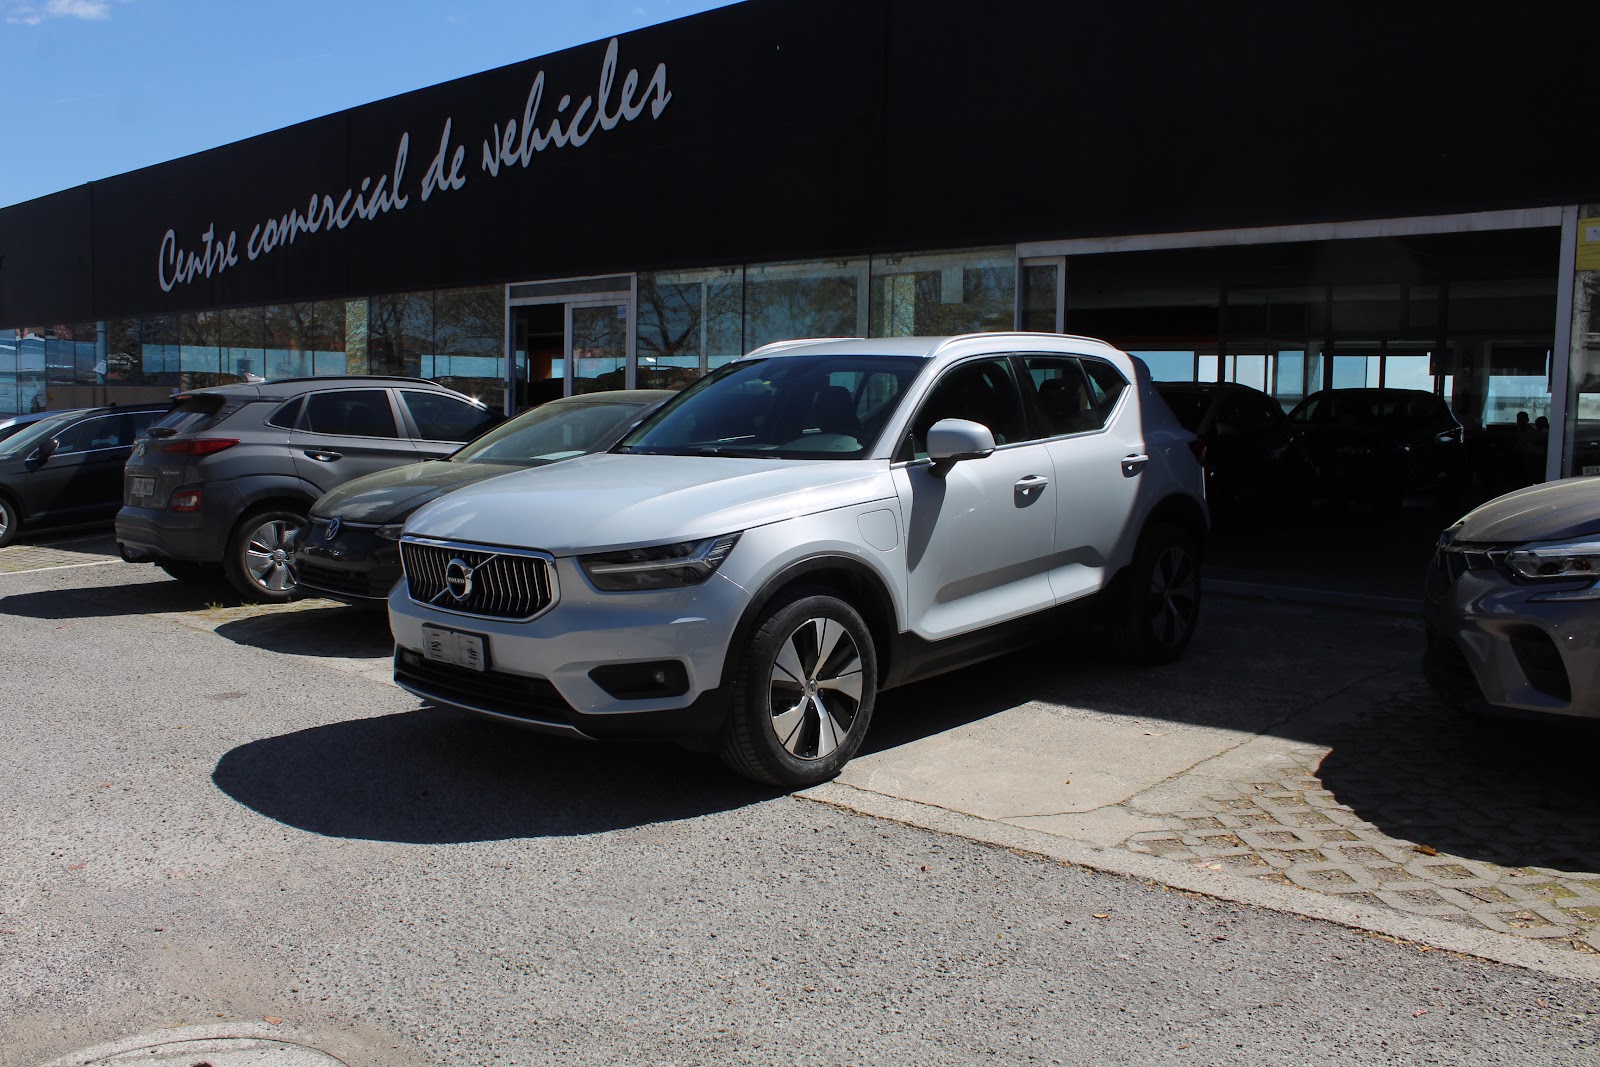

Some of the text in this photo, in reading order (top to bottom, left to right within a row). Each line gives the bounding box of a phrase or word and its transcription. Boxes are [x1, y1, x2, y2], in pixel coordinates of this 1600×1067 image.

[158, 37, 673, 292] Centre comercial de vehicles
